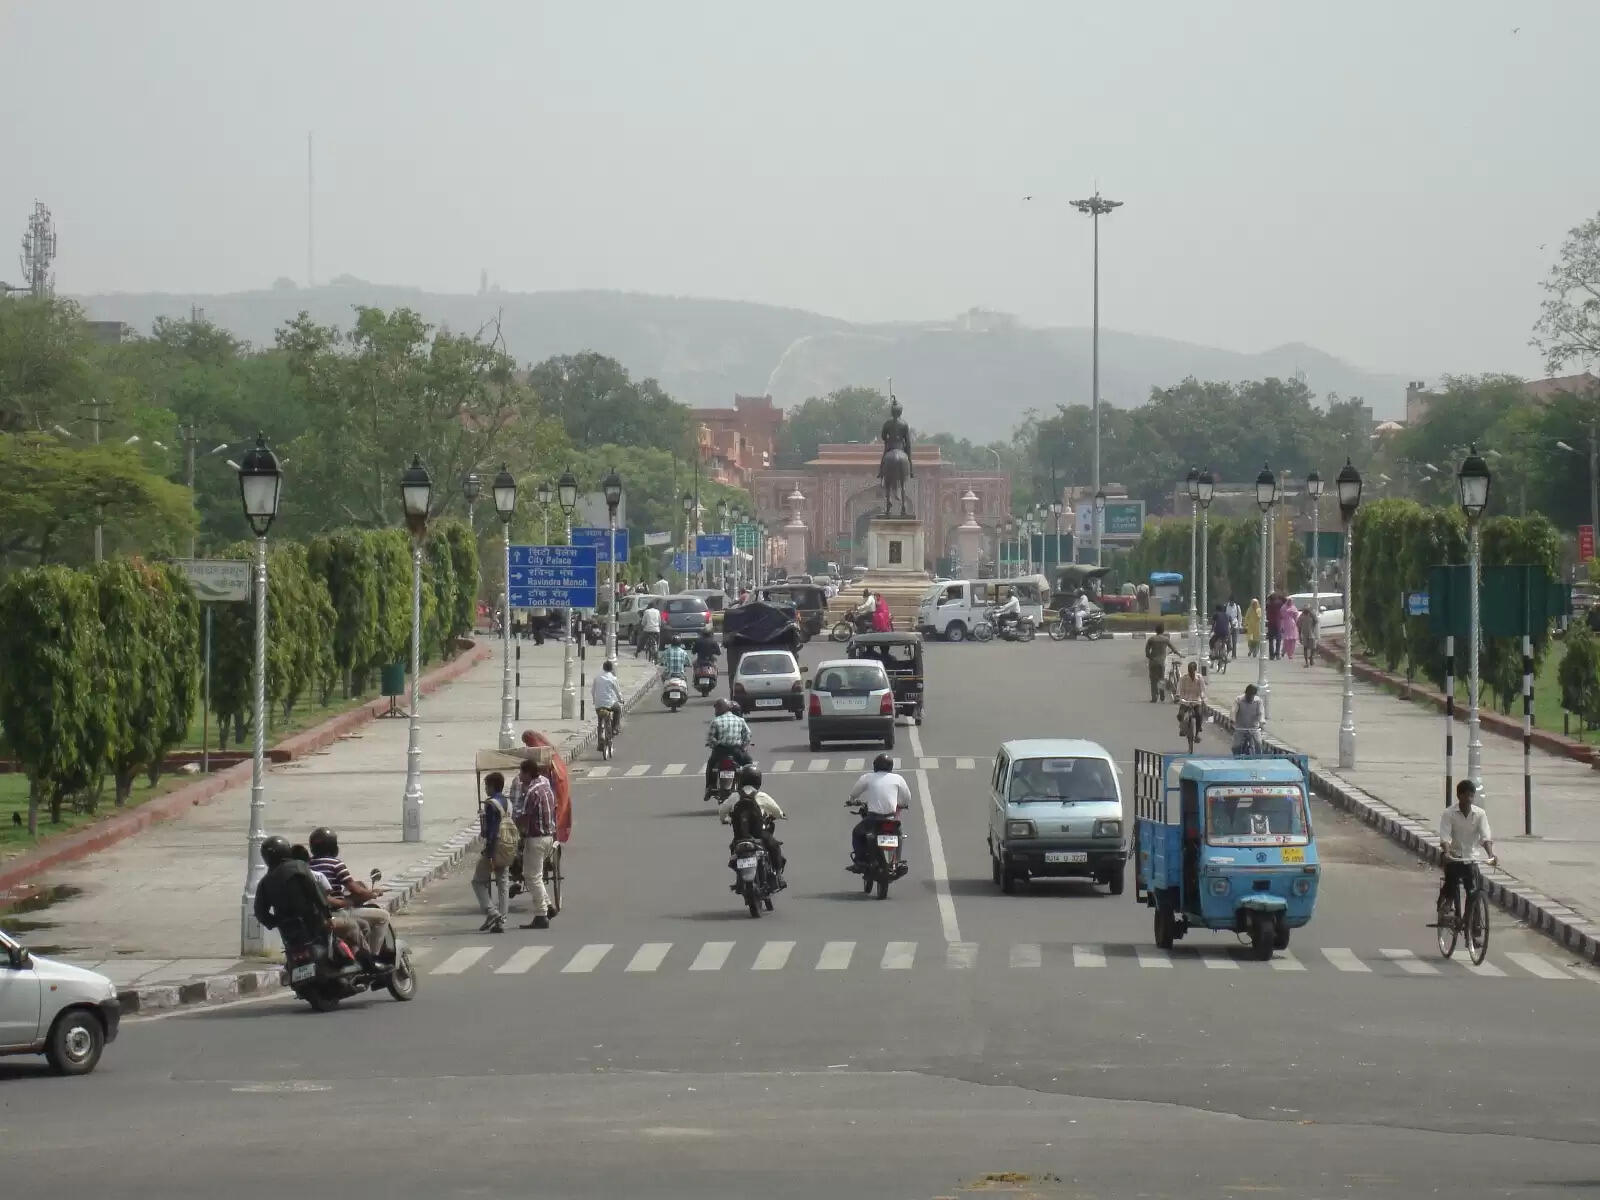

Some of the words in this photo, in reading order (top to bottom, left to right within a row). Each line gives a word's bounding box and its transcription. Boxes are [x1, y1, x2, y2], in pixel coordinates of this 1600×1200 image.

[528, 557, 544, 565] City
[528, 578, 561, 586] Ravindra
[528, 598, 547, 606] Tonk
[550, 598, 571, 606] Road
